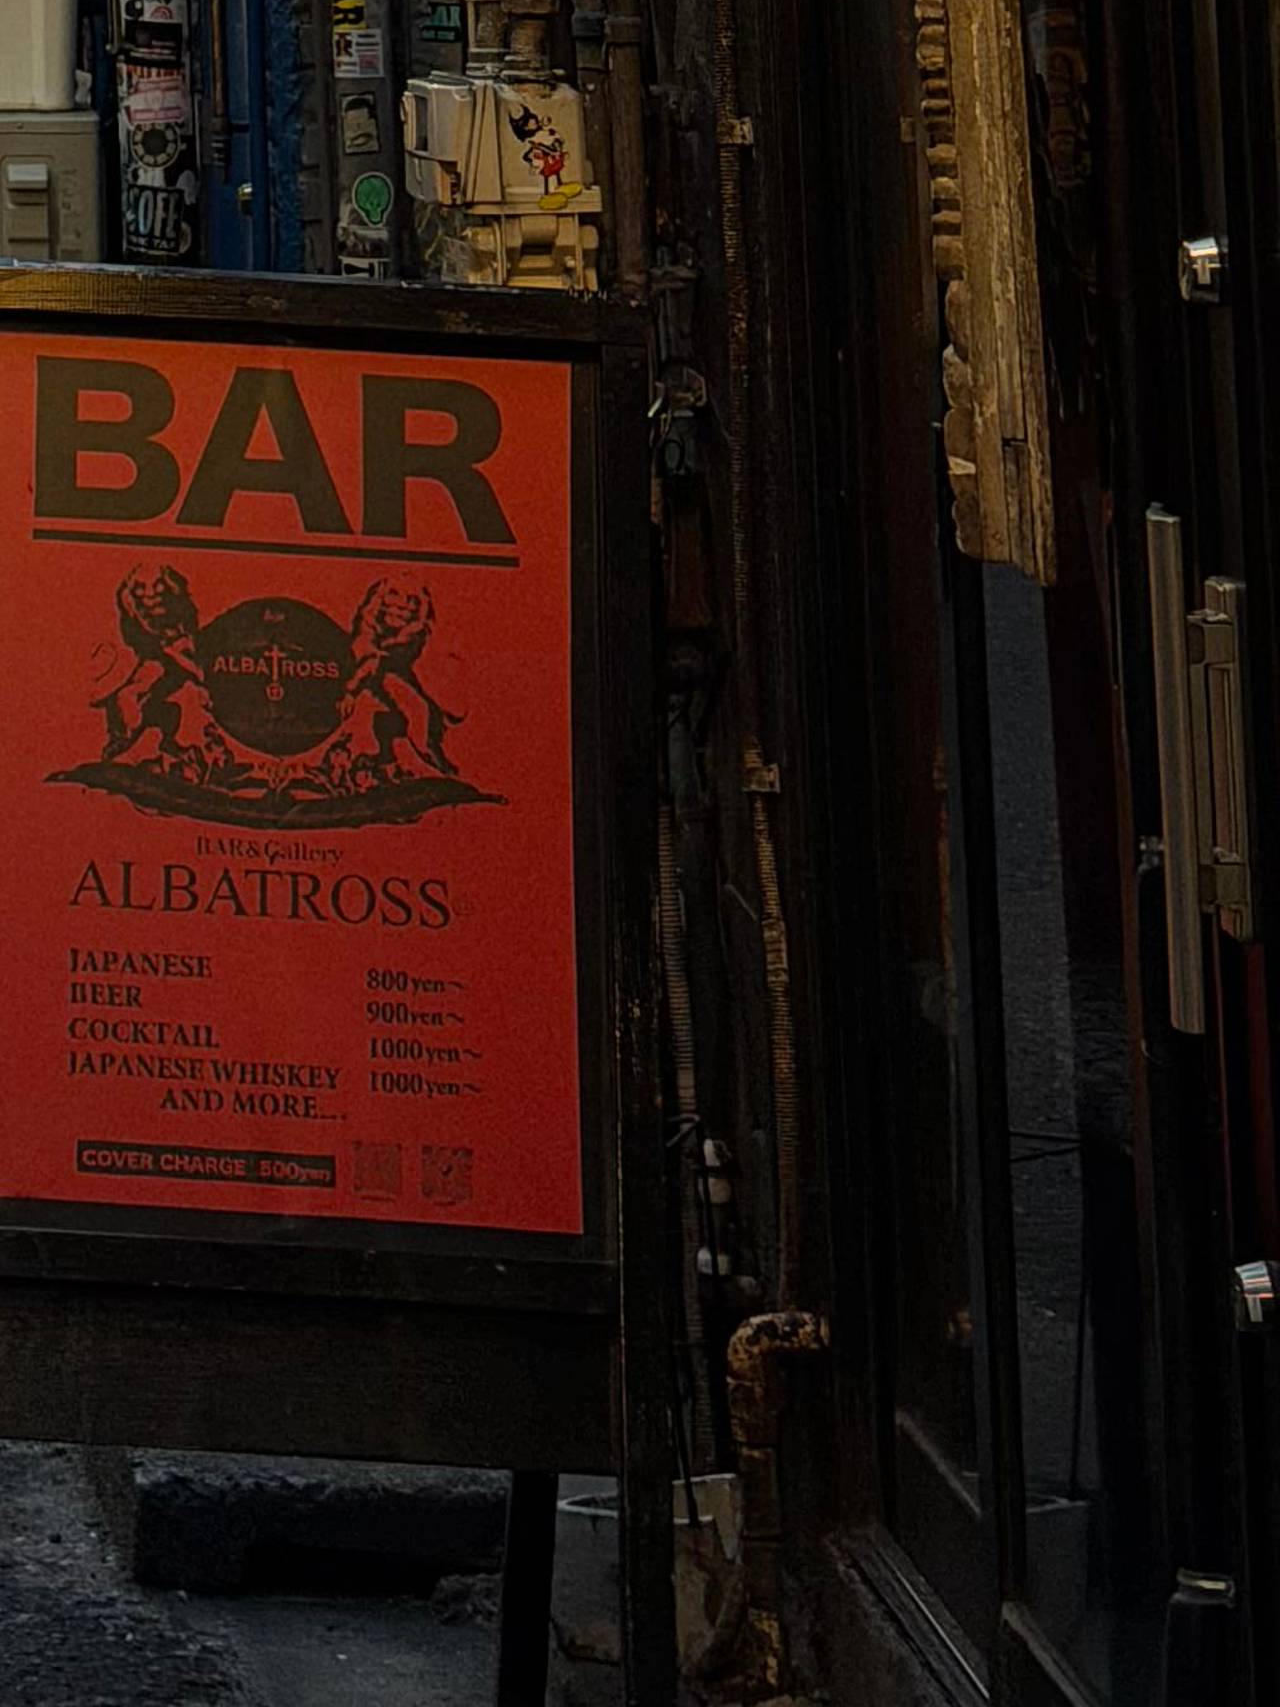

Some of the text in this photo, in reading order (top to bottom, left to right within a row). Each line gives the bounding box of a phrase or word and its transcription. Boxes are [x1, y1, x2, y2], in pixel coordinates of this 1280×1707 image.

[34, 355, 517, 545] BAR
[214, 644, 340, 682] ALBATROSS
[70, 860, 451, 929] ALBATROSS
[69, 949, 213, 979] JAPANESE
[69, 982, 143, 1009] BEER
[68, 1018, 220, 1048] COCKTAIL
[67, 1052, 341, 1090] JAPANESE WHISKEY
[160, 1089, 224, 1113] AND
[82, 1149, 153, 1169] COVER
[160, 1154, 246, 1176] CHARGE
